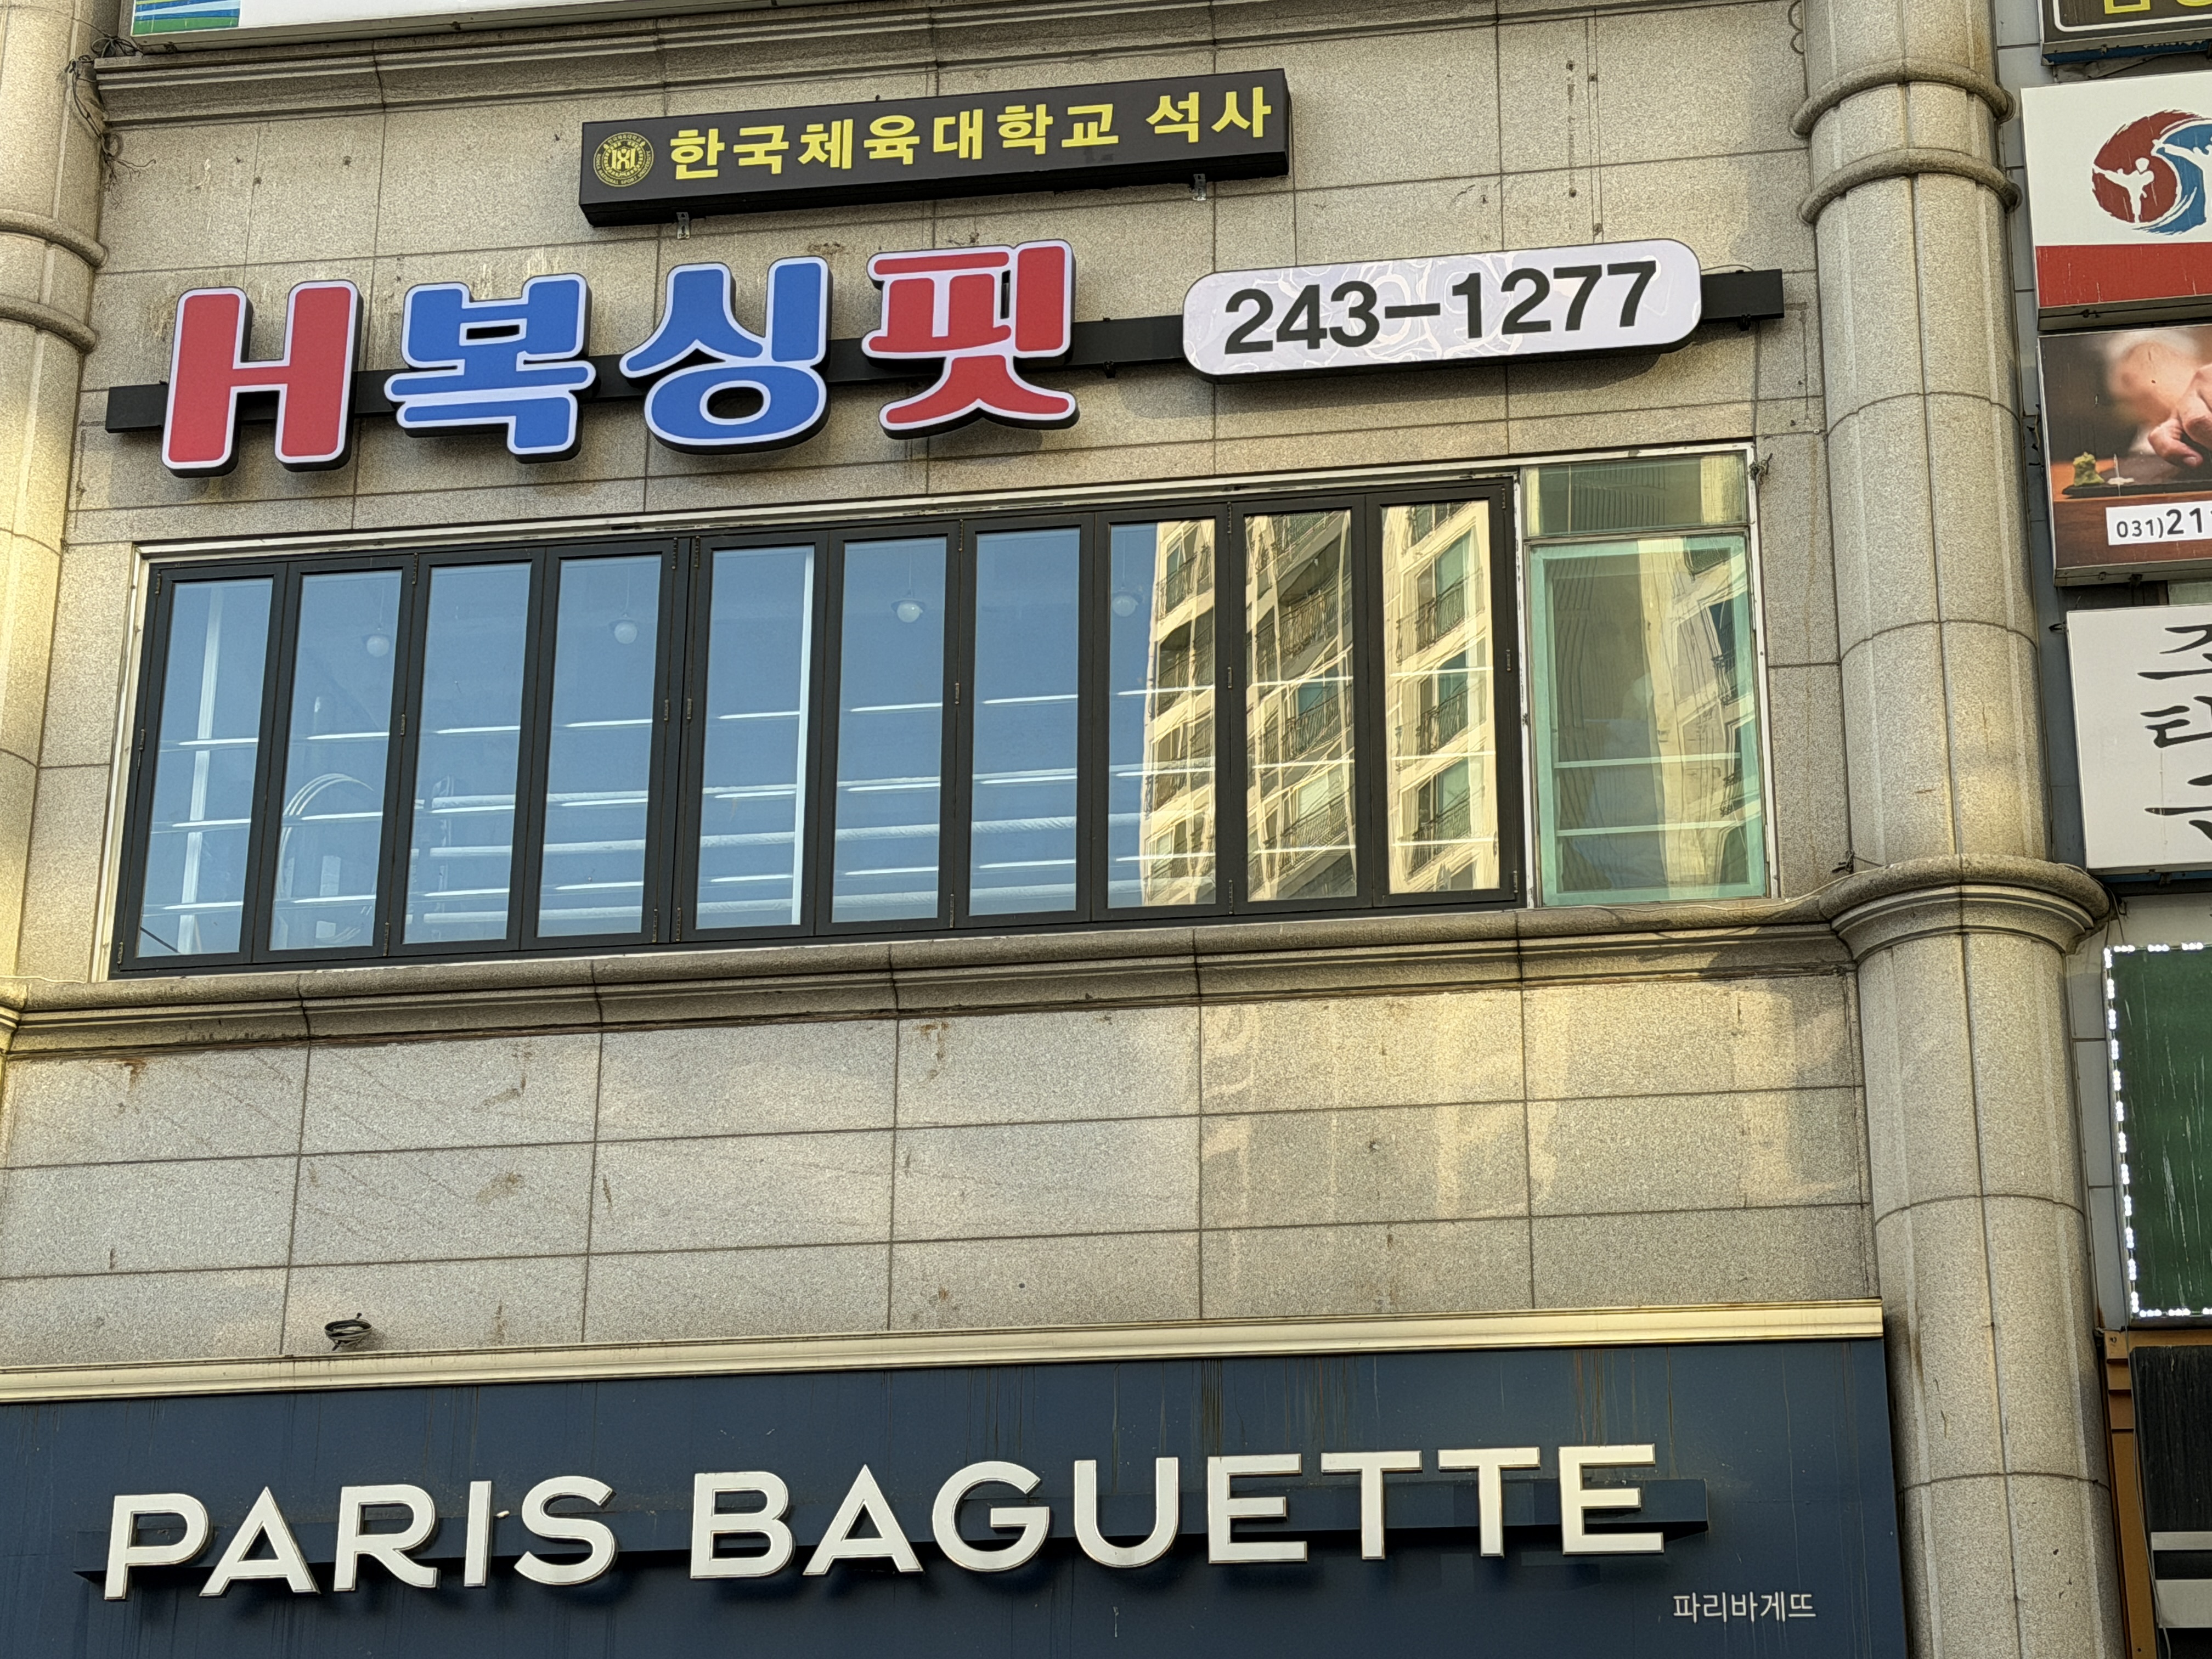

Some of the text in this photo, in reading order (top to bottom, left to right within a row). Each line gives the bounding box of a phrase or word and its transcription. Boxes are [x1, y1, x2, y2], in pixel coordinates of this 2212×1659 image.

[670, 87, 1272, 180] 한국체육대학교 석사
[1224, 261, 1656, 355] 243-1277
[2117, 507, 2212, 538] 031)21
[104, 1443, 1664, 1600] PARIS BAGUETTE
[1673, 1591, 1816, 1623] 파리바게뜨
